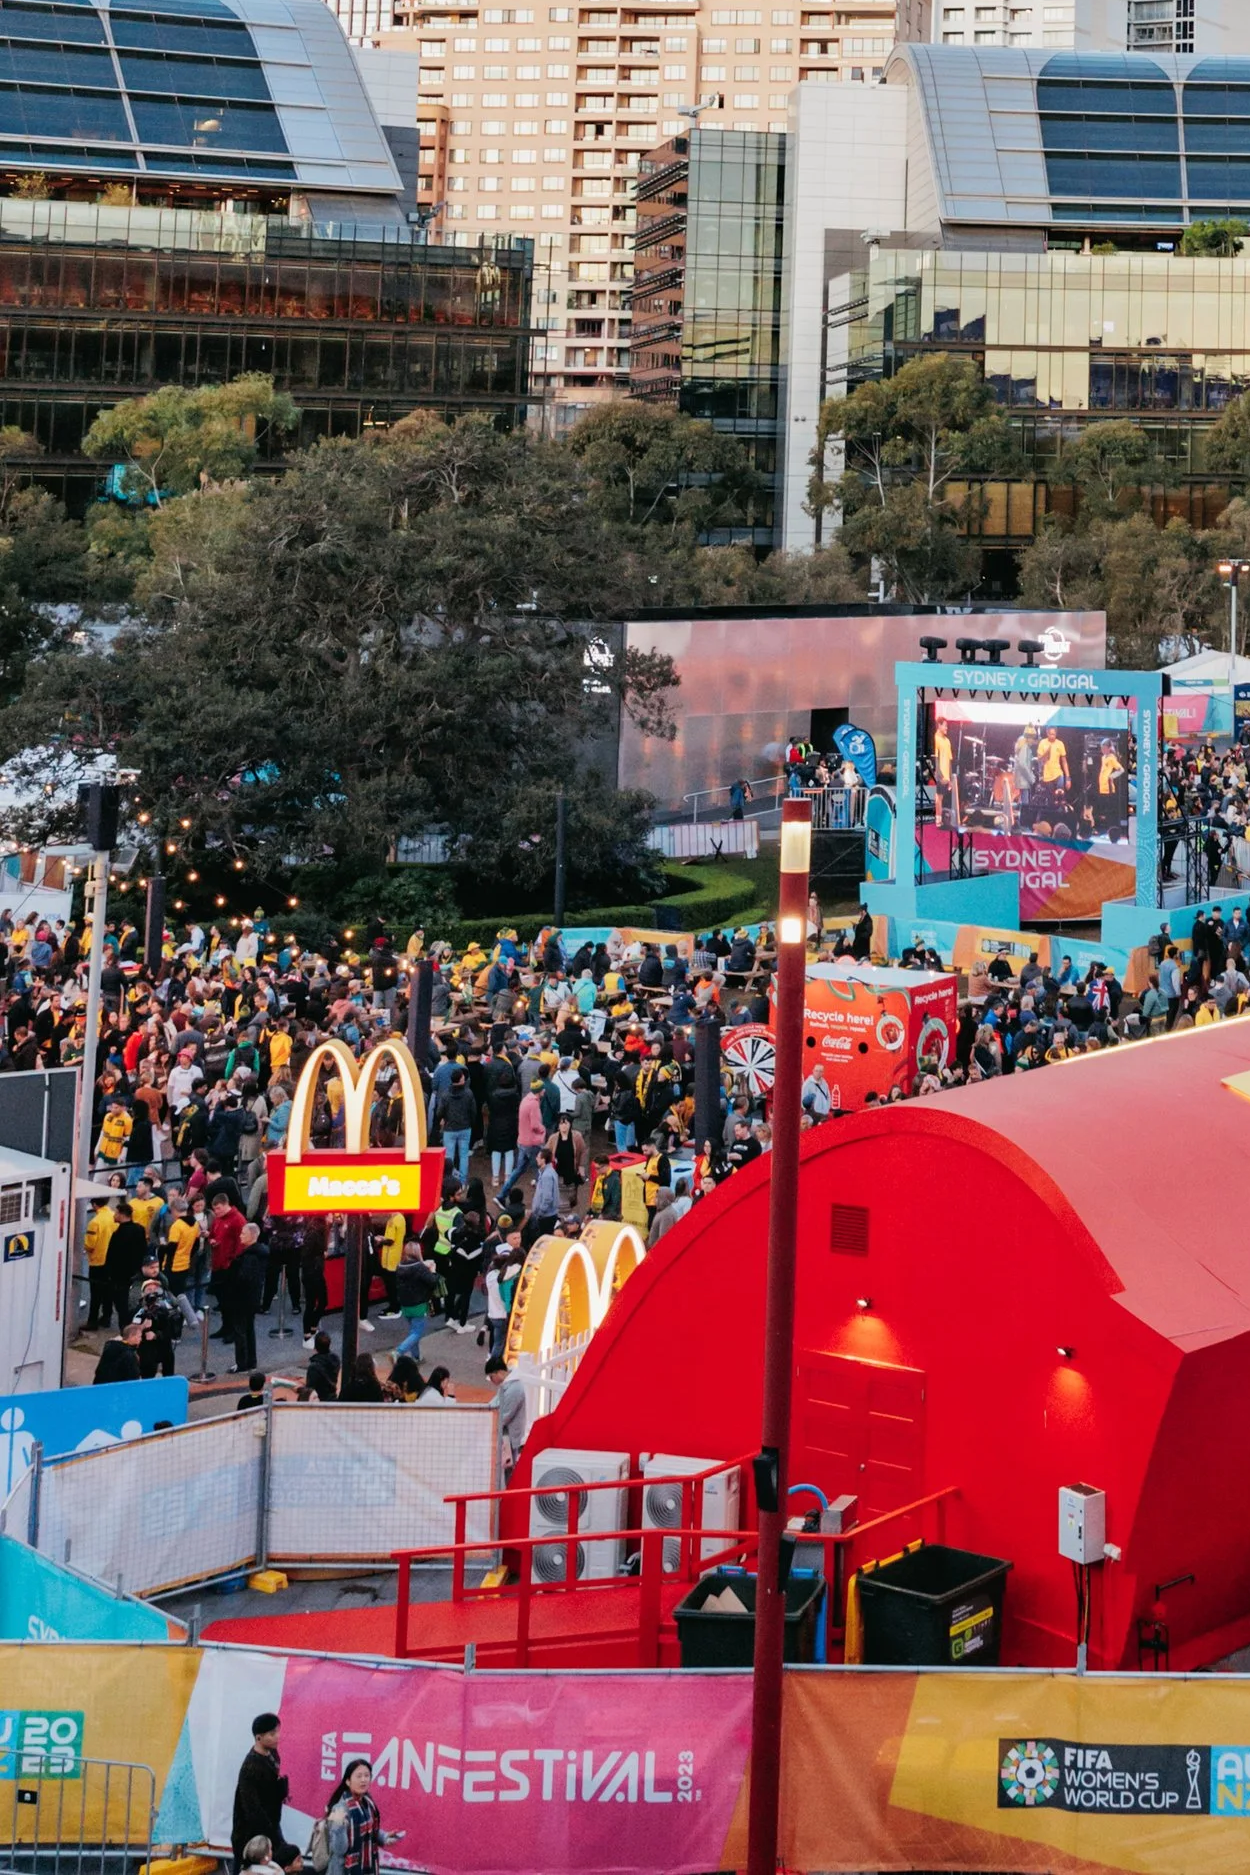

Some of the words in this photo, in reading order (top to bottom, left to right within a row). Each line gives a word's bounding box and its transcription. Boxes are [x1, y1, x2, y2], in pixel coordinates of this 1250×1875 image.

[953, 670, 1018, 687] SYDNEY
[1027, 673, 1099, 690] GADIGAL
[1143, 709, 1152, 758] SYDNEY
[974, 849, 1068, 867] SYDNEY
[1020, 871, 1070, 888] IGAL
[803, 1008, 845, 1023] Recycle
[847, 1012, 875, 1026] here!
[307, 1175, 400, 1197] Macca's
[23, 1717, 78, 1745] 20
[320, 1731, 338, 1781] FIFA
[676, 1750, 695, 1803] 2023
[1064, 1747, 1113, 1770] FIFA
[1065, 1769, 1159, 1789] WOMEN'S
[1064, 1787, 1134, 1809] WORLD
[1137, 1792, 1179, 1809] CUP
